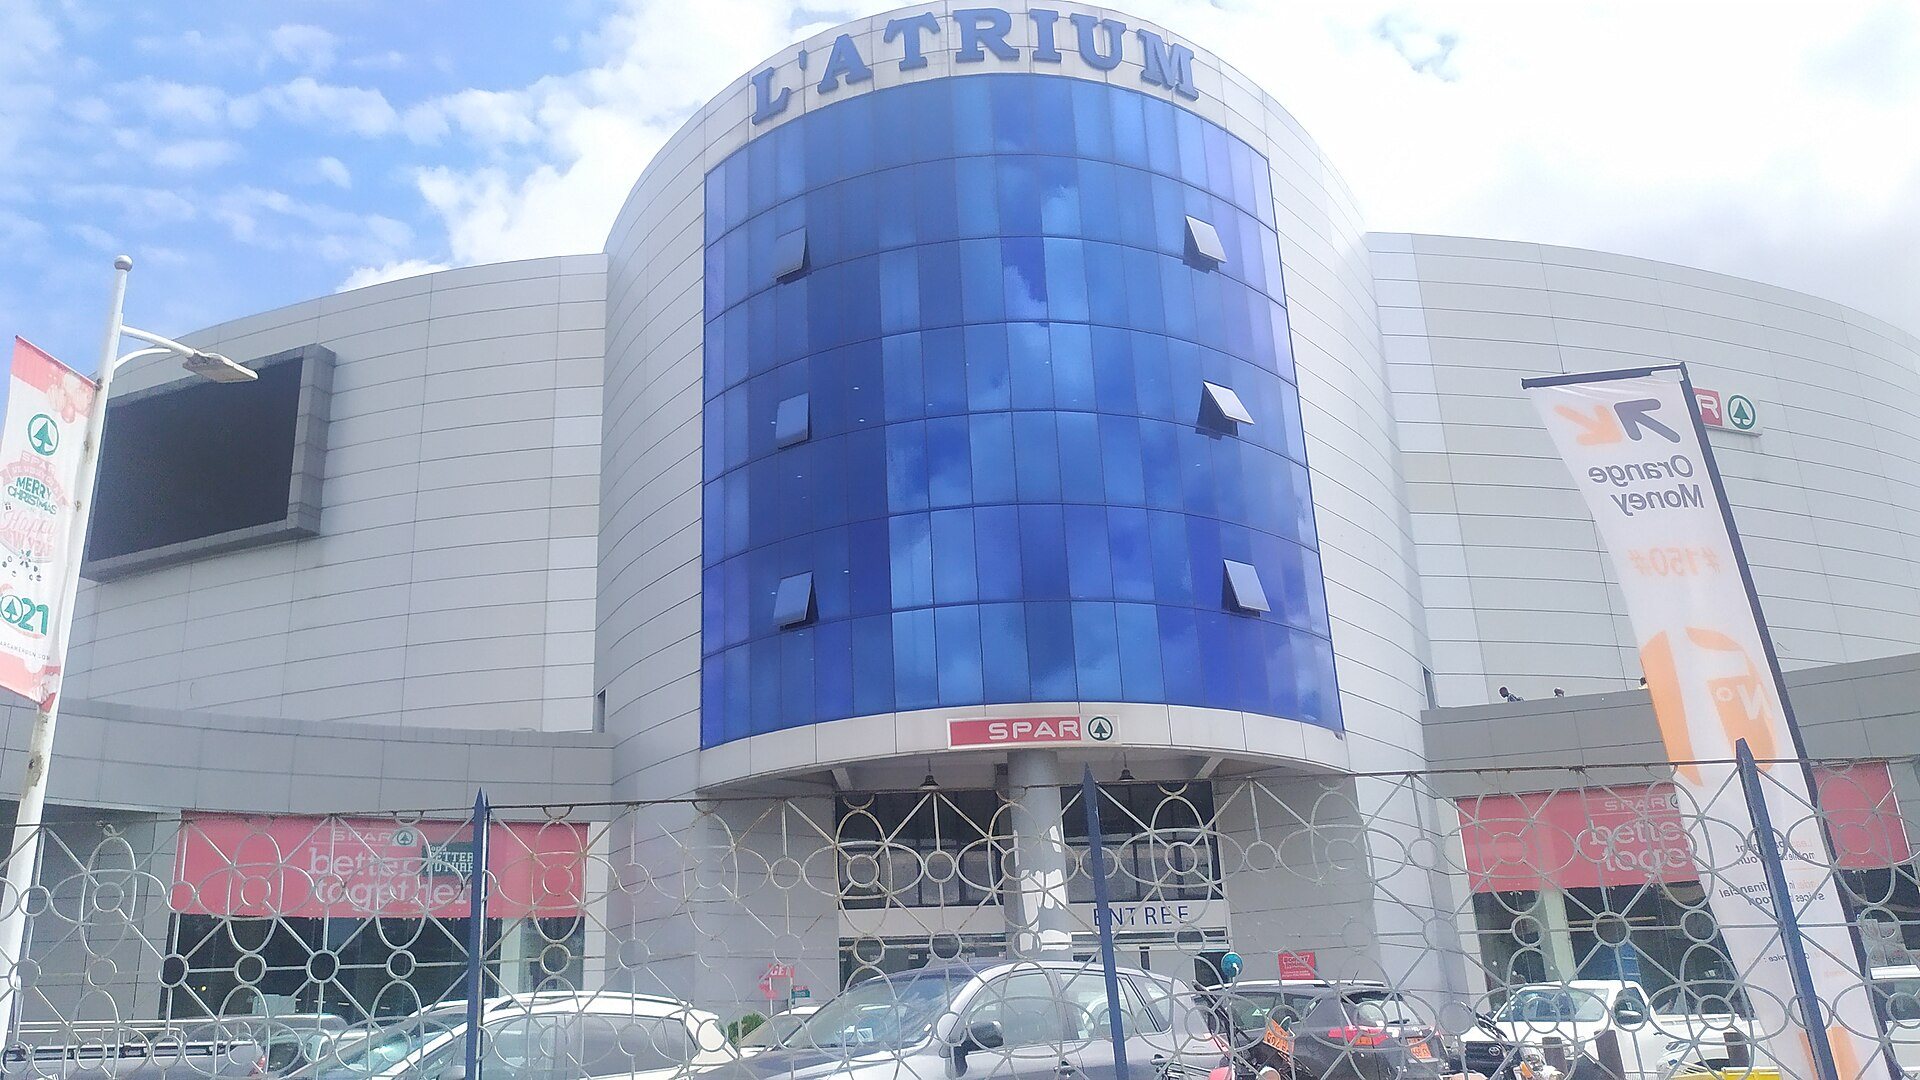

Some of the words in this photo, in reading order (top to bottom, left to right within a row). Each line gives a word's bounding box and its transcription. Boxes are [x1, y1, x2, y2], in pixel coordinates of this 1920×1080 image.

[751, 8, 1200, 125] L'ATRIUM
[8, 485, 58, 515] CHRISTMAS
[16, 477, 53, 501] MERRY
[988, 720, 1080, 741] SPAR
[1604, 796, 1666, 812] SPAR
[333, 830, 392, 843] SPAR
[1589, 820, 1683, 845] bette
[308, 847, 416, 876] better
[1602, 847, 1690, 879] toge
[315, 877, 472, 912] together
